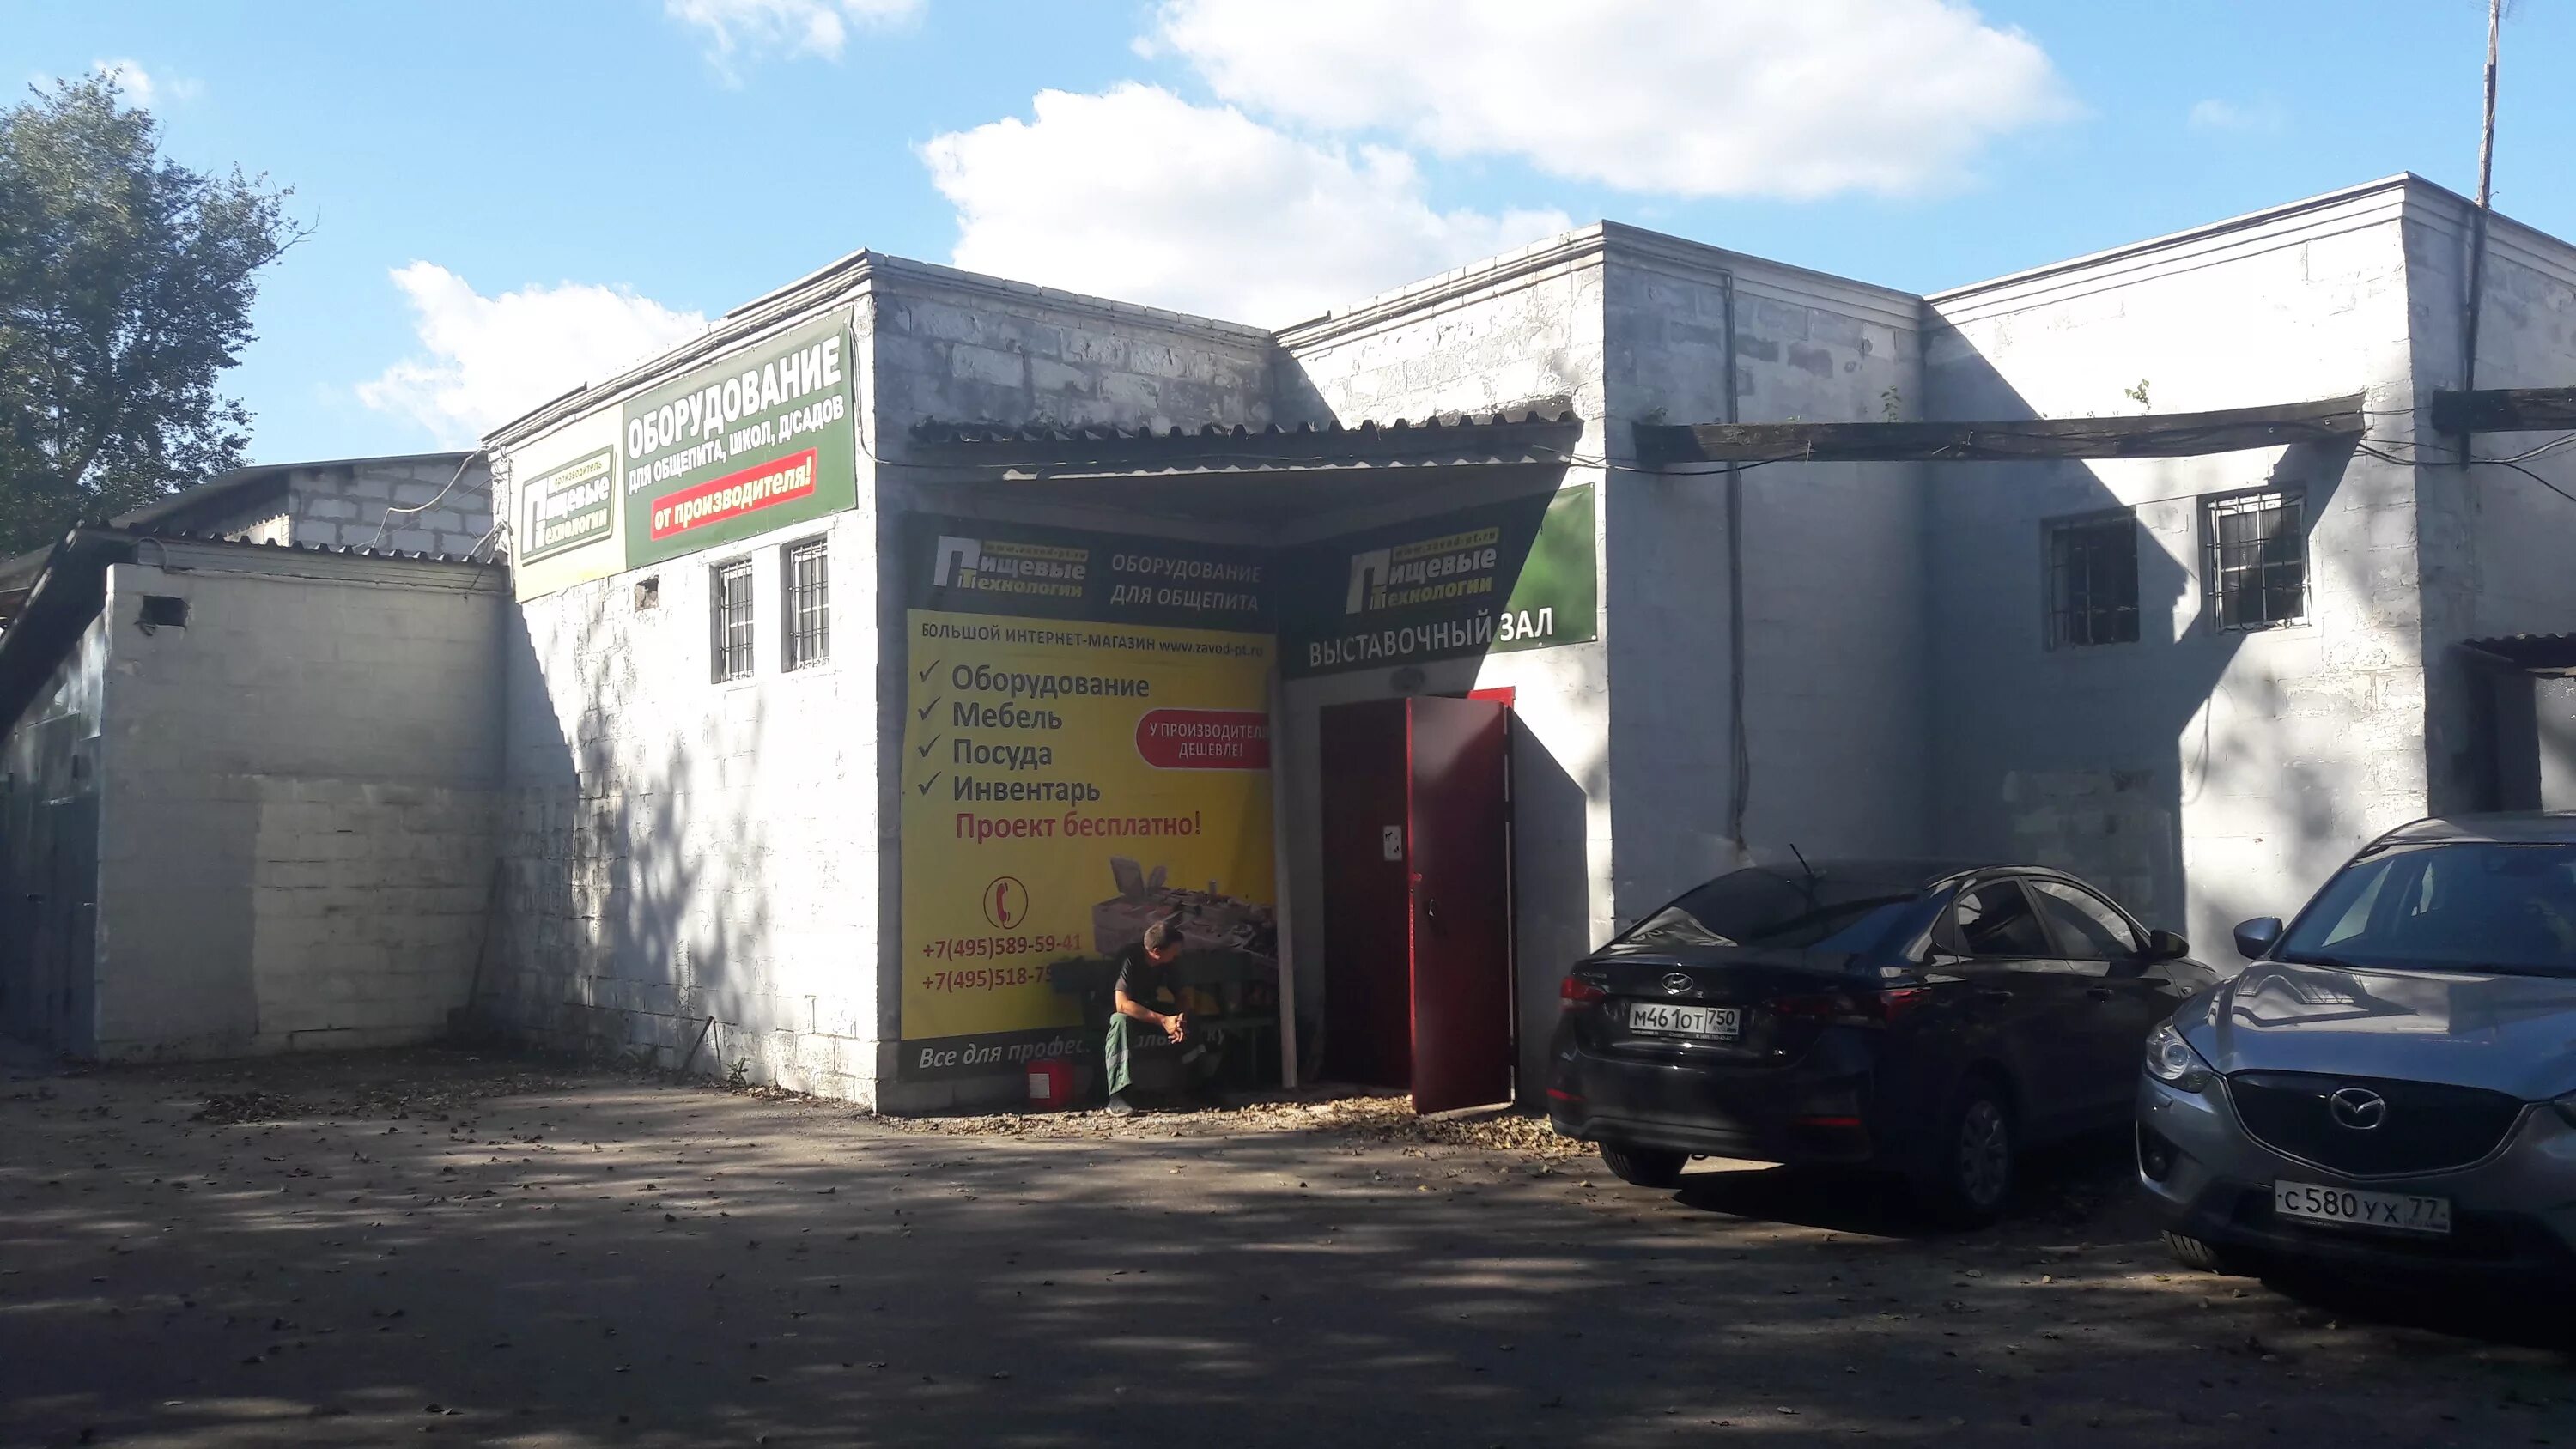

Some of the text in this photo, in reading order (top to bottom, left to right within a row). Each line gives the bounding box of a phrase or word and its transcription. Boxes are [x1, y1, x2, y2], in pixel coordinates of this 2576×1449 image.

[627, 336, 841, 460] ОБОРУДОВАНИЕ
[628, 394, 845, 496] ДЛЯ ОБЩЕПИТА, ШКОЛ, Д/САДОВ
[554, 460, 602, 488] производитель
[654, 457, 812, 530] от производителя!
[523, 476, 610, 553] Пищевые
[535, 508, 608, 549] Технологии
[934, 536, 1086, 586] Пищевые
[1112, 553, 1262, 585] ОБОРУДОВАНИЕ
[957, 569, 1083, 598] Технологии
[1346, 548, 1497, 614] Пищевые
[1370, 576, 1492, 610] Технологии
[1110, 585, 1259, 612] ДЛЯ ОБЩЕПИТА
[921, 621, 1263, 658] БОЛЬШОЙ ИНТЕРНЕТ-МАГАЗИН www.zavod-pt.ru
[1310, 607, 1553, 667] ВЫСТАВОЧНЫЙ ЗАЛ
[951, 664, 1150, 699] Оборудование
[953, 701, 1062, 730] Мебель
[1150, 723, 1157, 737] У
[953, 738, 1053, 771] Посуда
[1178, 743, 1243, 759] ДЕШЕВЛЕ!
[954, 775, 1101, 807] Инвентарь
[956, 811, 1202, 844] Проект бесплатно!
[922, 934, 1082, 962] +7(495)589-59-41
[1708, 1009, 1735, 1026] 750
[919, 1047, 957, 1070] Все
[963, 1043, 1003, 1065] для
